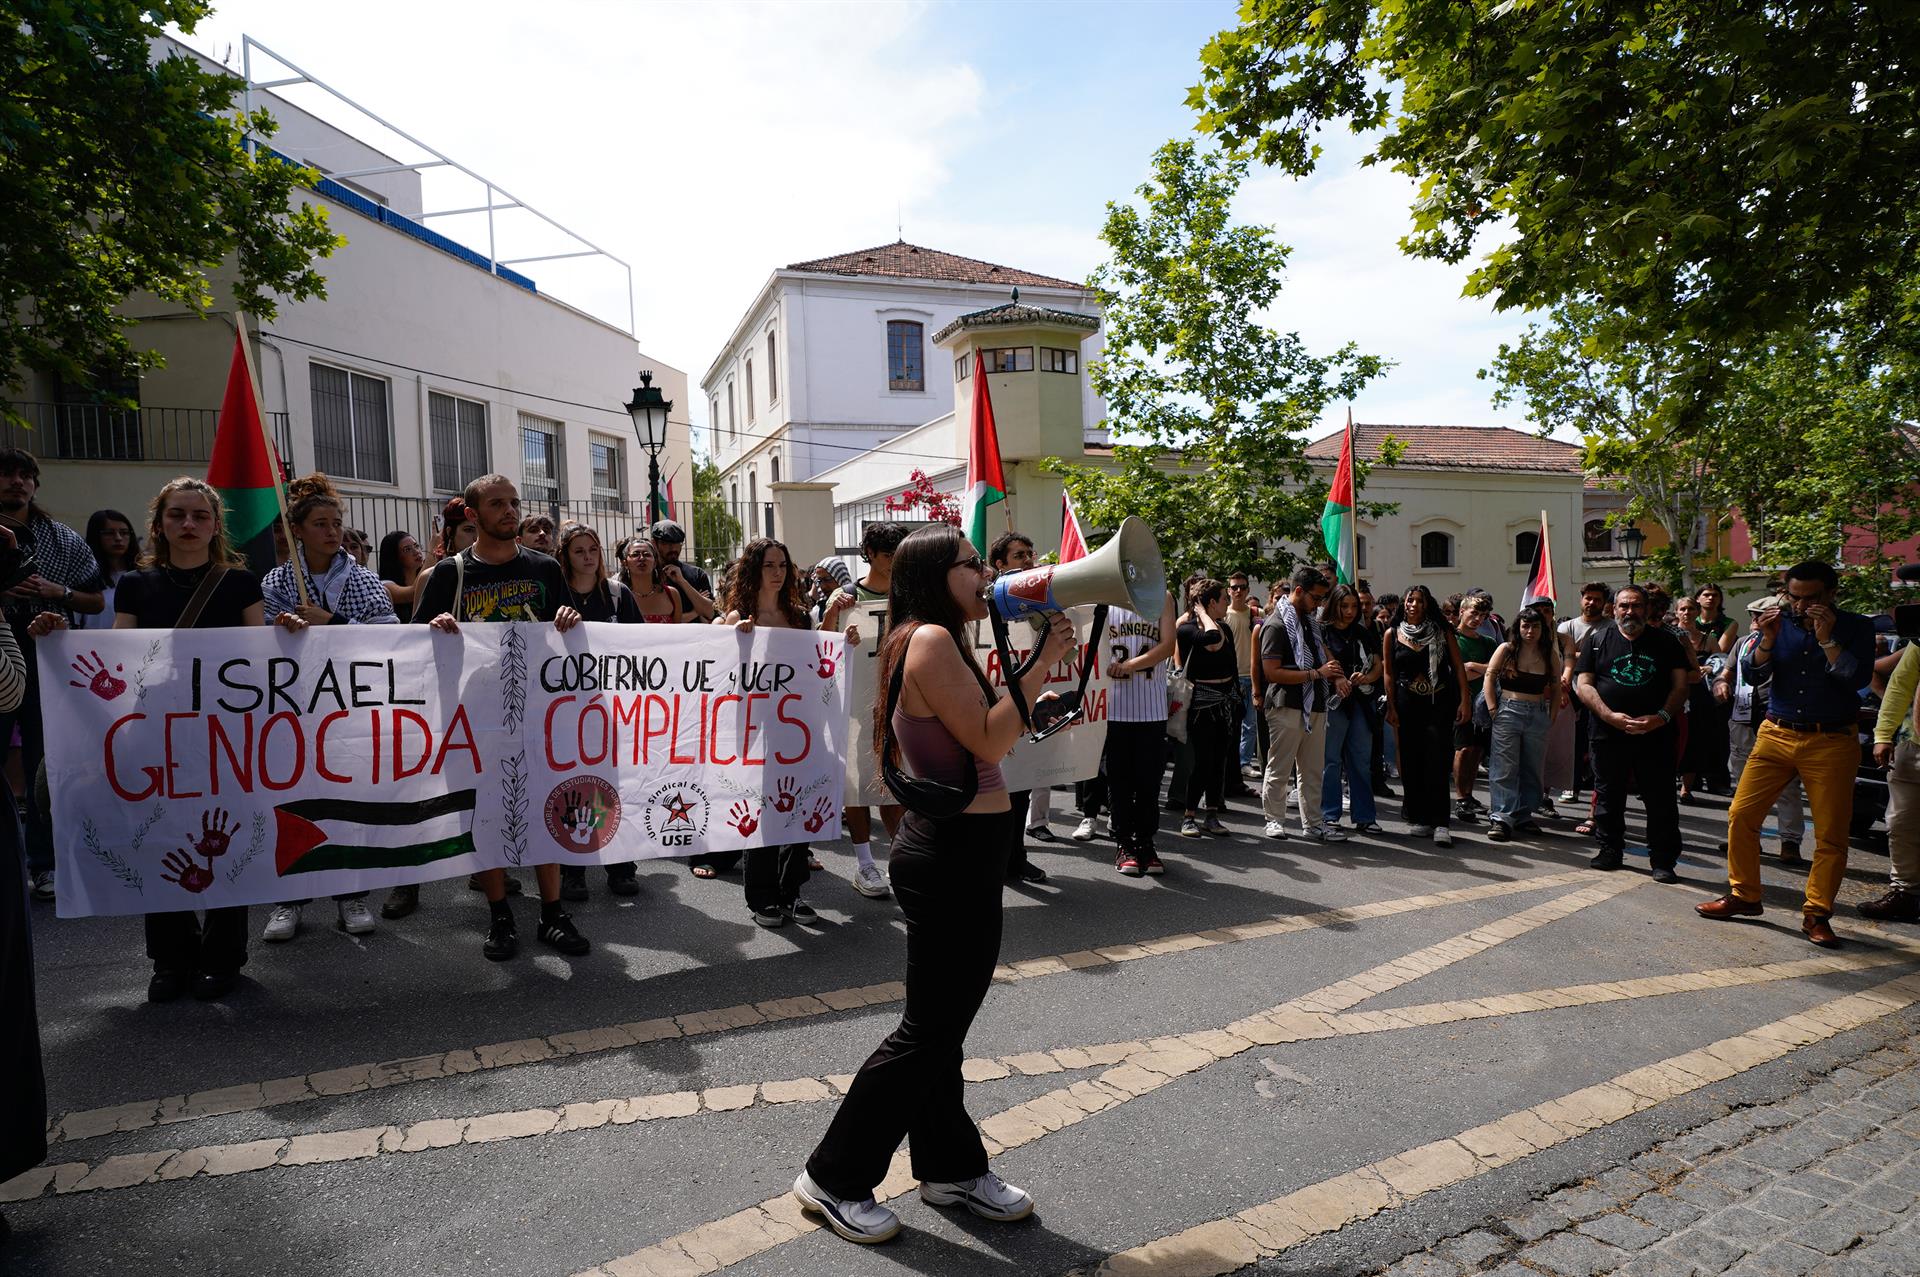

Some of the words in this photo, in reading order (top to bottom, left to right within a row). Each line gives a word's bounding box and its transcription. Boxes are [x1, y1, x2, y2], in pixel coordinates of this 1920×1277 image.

[1109, 625, 1118, 640] S
[191, 656, 426, 716] ISRAEL
[683, 659, 716, 693] UE
[740, 661, 795, 693] UGR
[544, 693, 812, 772] CÓMPLICES
[103, 704, 483, 802] GENOCIDA
[552, 787, 562, 799] DE
[561, 776, 610, 791] ESTUDIANTES
[648, 781, 687, 805] Sindical
[545, 799, 560, 838] ASAMBLEA
[662, 834, 693, 847] USE
